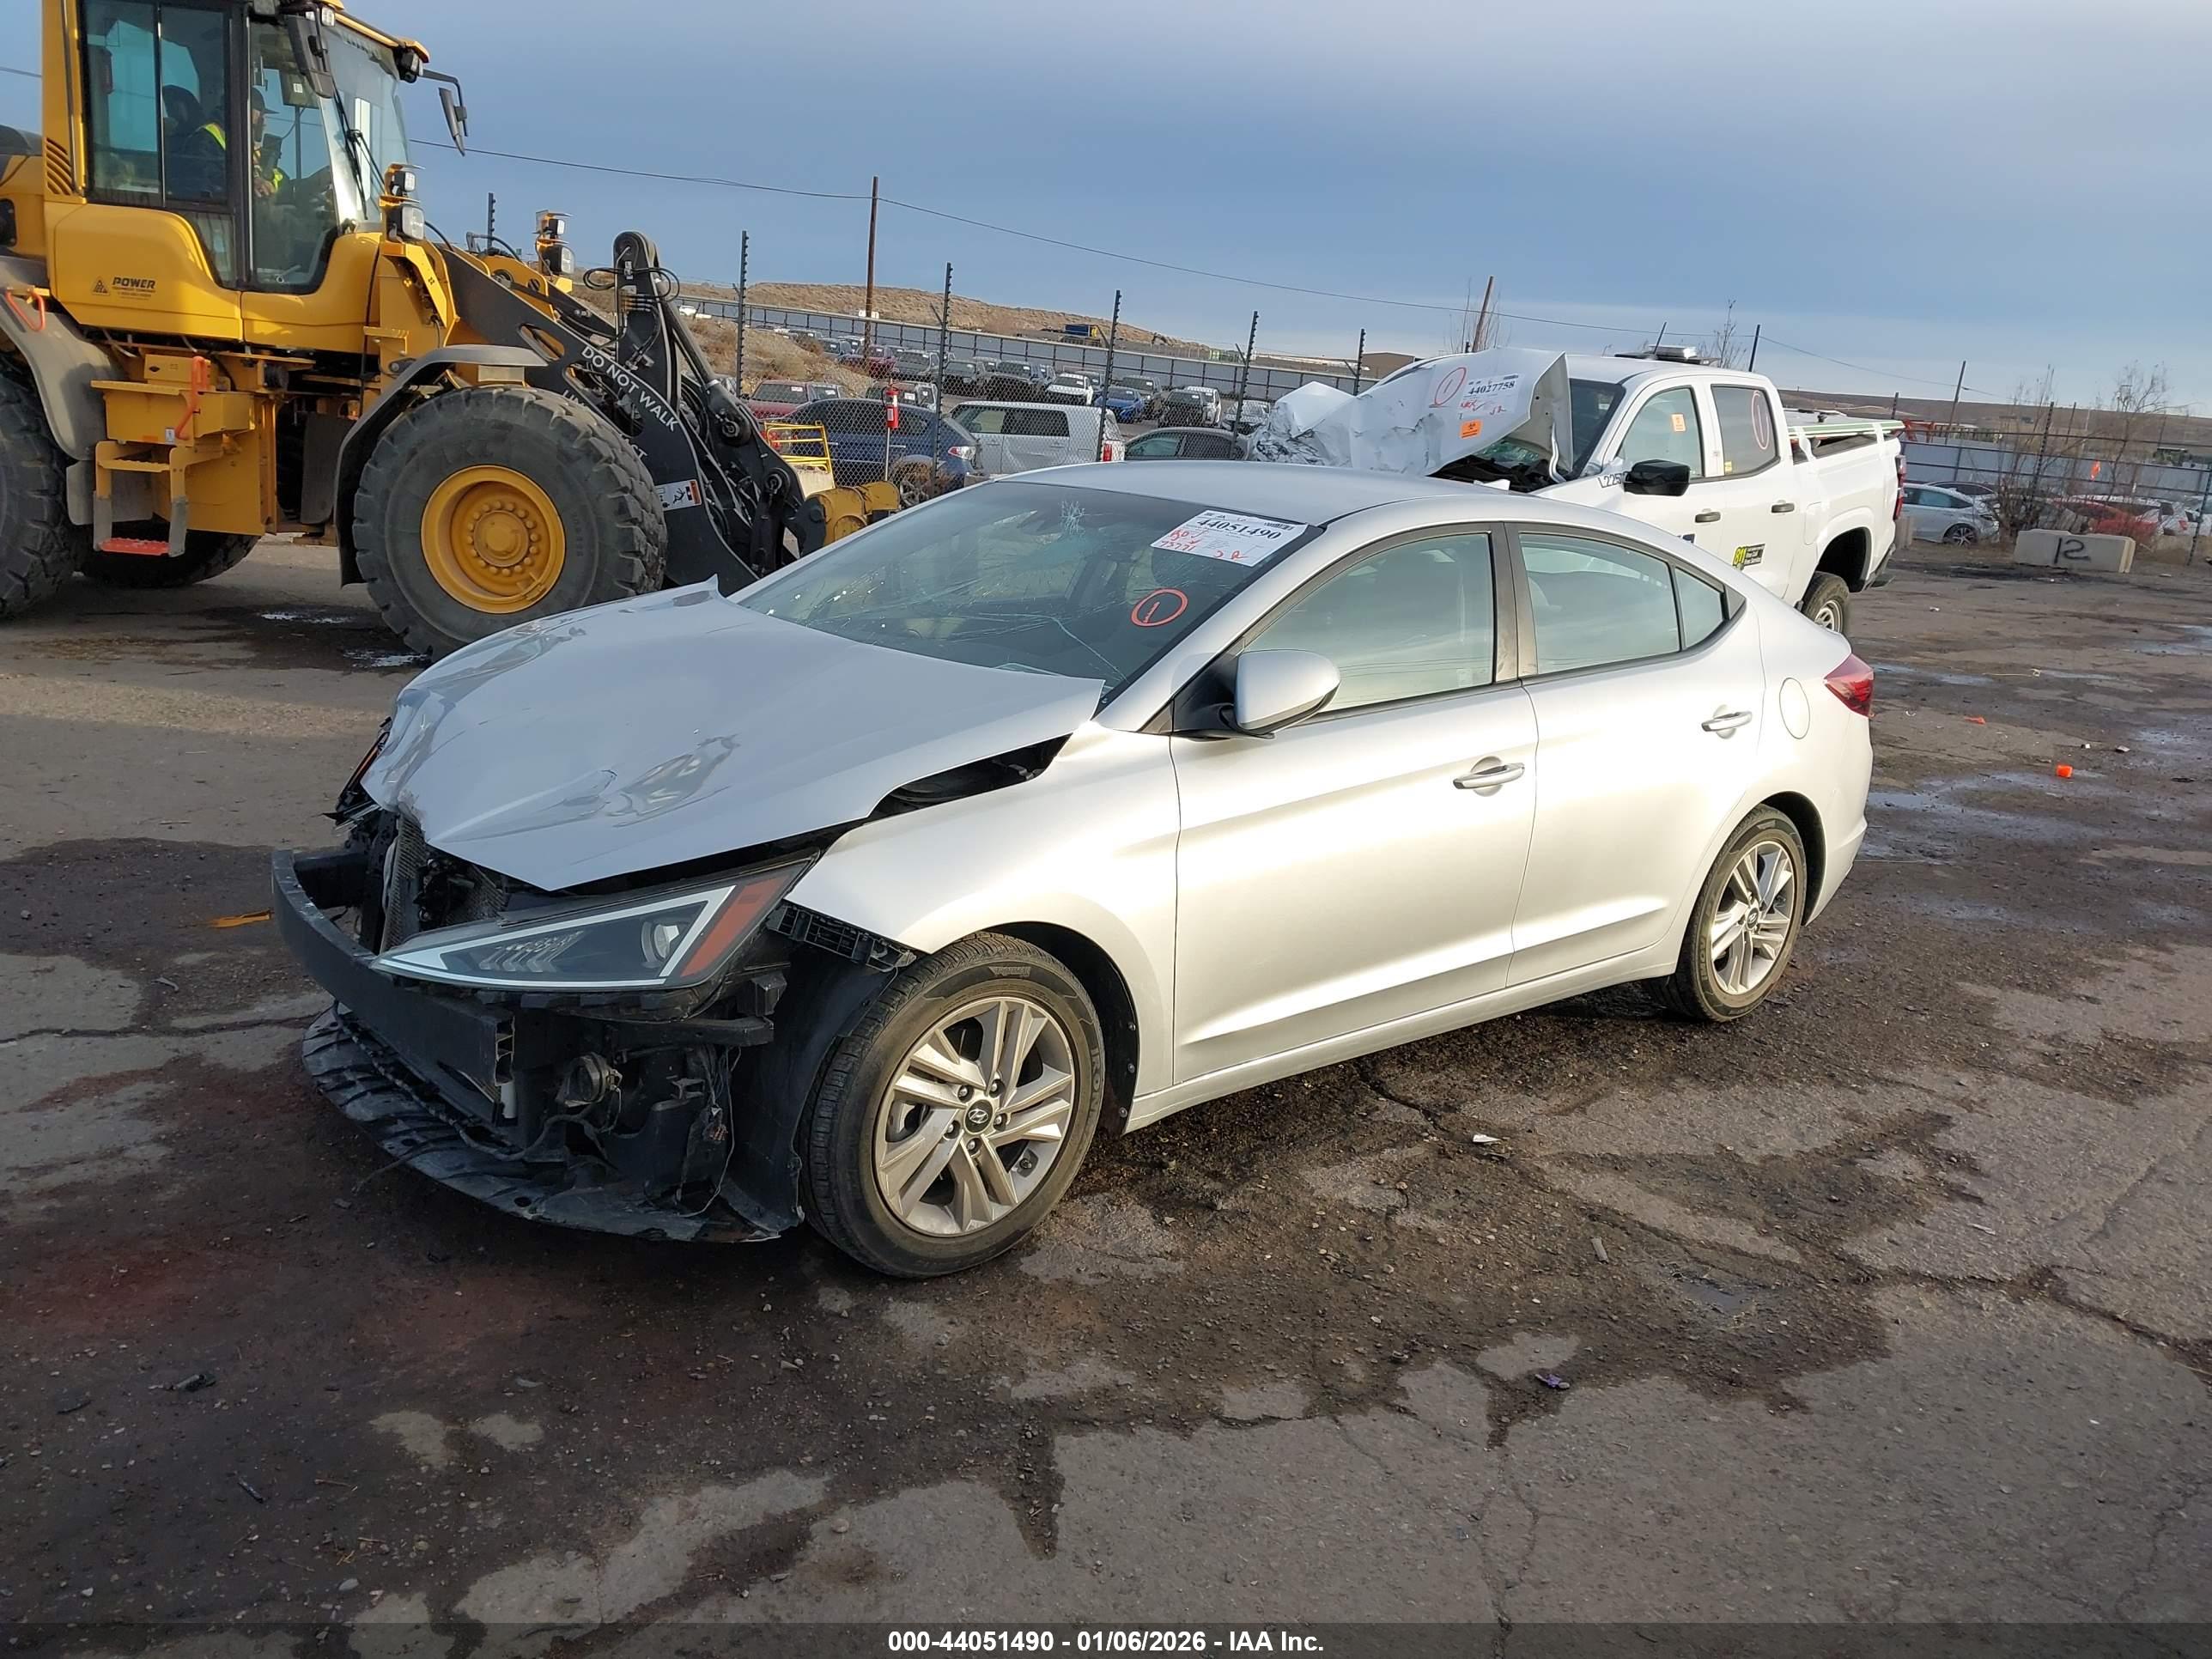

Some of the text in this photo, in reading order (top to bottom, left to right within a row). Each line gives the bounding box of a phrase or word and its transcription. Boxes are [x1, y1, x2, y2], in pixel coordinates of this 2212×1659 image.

[112, 276, 156, 289] POWER
[581, 345, 679, 432] DO NOT WALK
[1468, 380, 1516, 395] 44027758
[1197, 519, 1281, 540] 44051490
[1733, 546, 1747, 567] 811
[2054, 538, 2091, 564] 12
